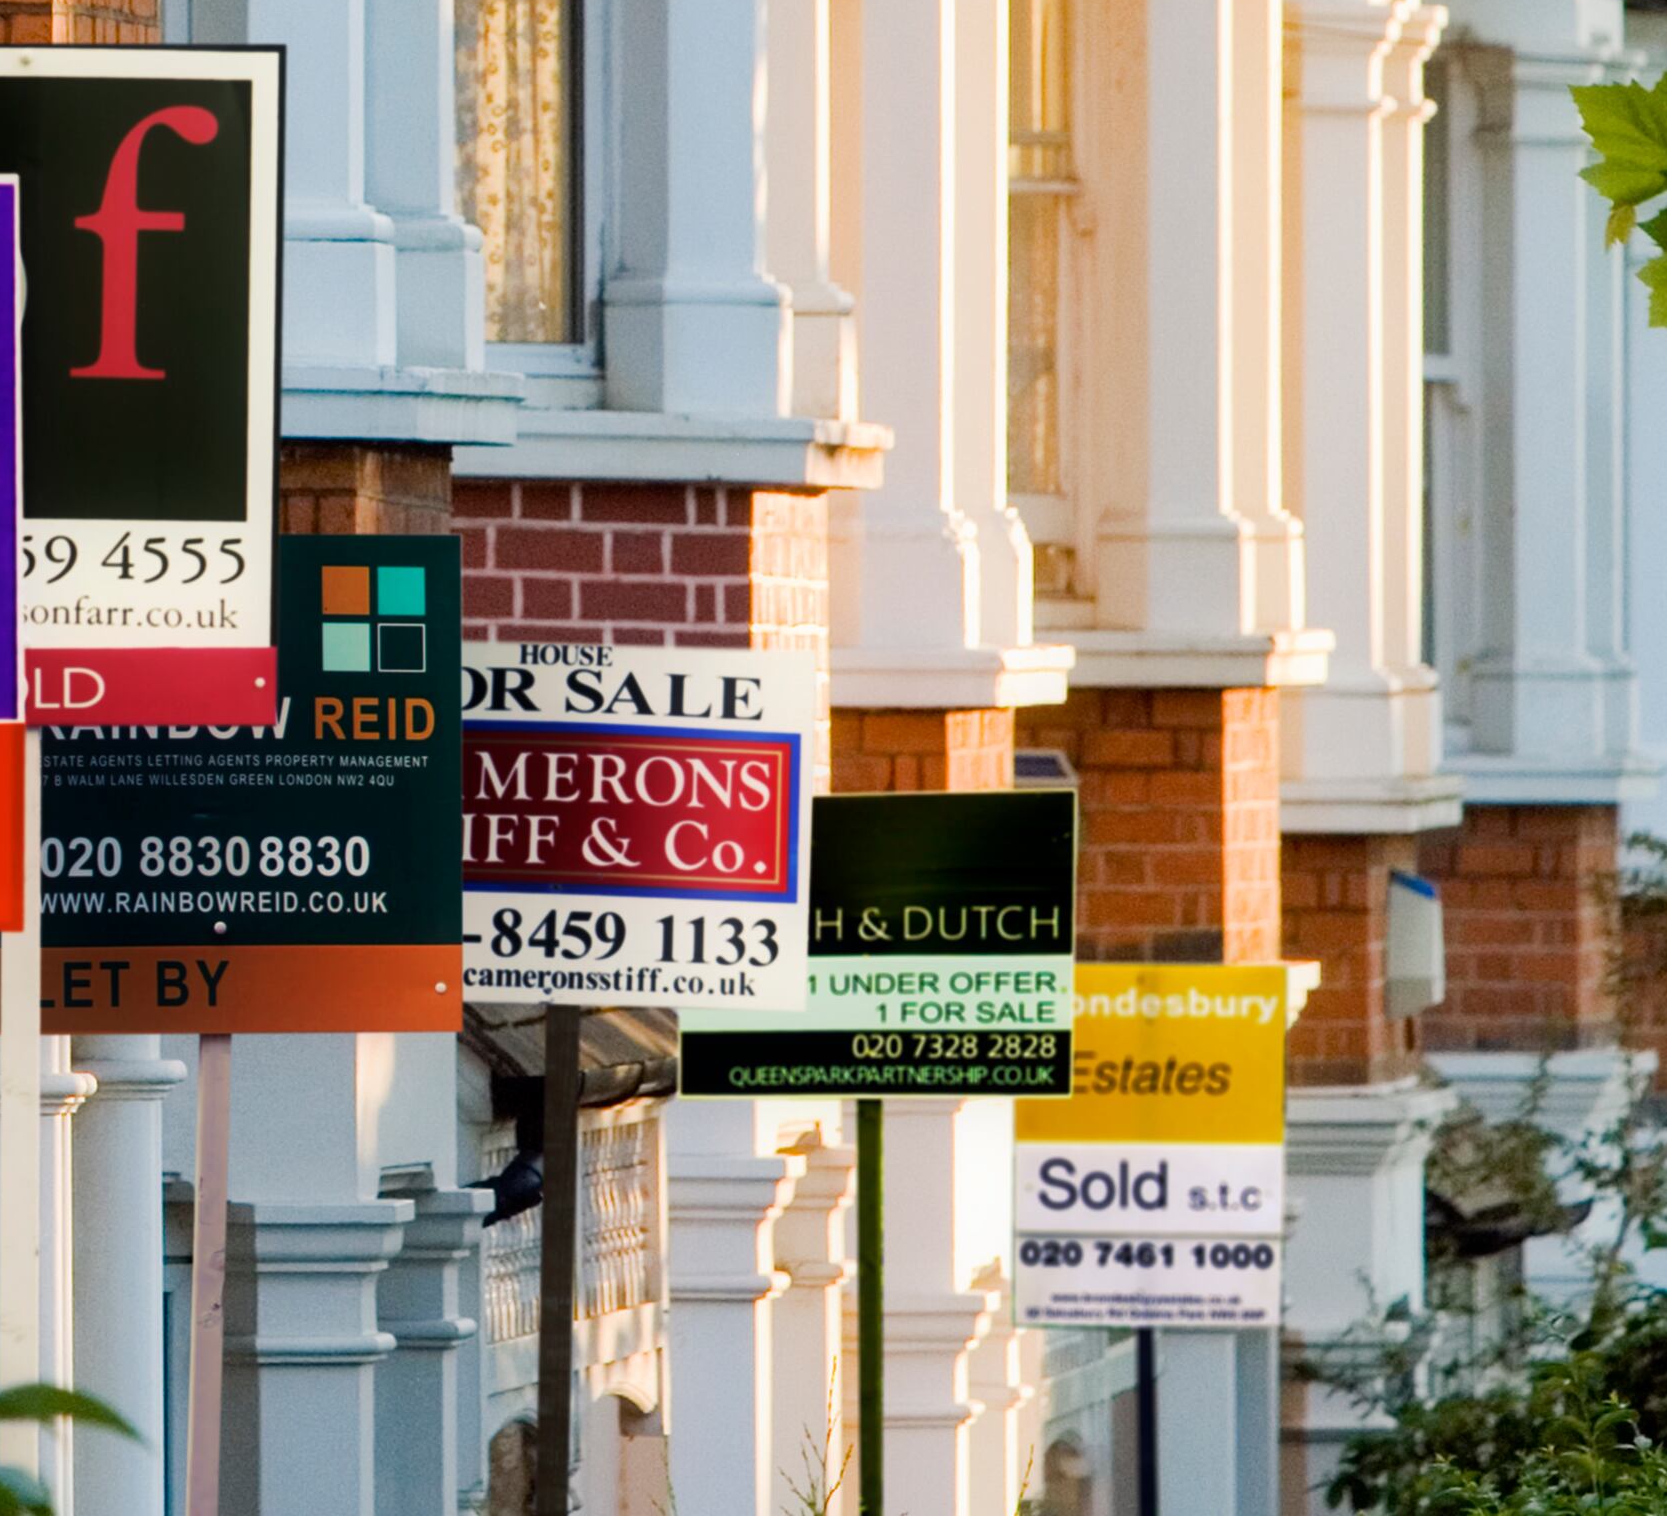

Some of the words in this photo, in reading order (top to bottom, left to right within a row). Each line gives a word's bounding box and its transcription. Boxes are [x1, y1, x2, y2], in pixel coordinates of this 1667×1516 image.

[69, 105, 218, 379] f
[101, 531, 245, 584] 4555
[519, 643, 613, 667] HOUSE
[24, 667, 105, 709] LD
[565, 668, 764, 721] SALE
[314, 696, 435, 741] REID
[41, 754, 84, 768] STATE
[89, 755, 142, 767] AGENTS
[147, 754, 203, 767] LETTING
[208, 754, 260, 767] AGENTS
[266, 754, 334, 767] PROPERTY
[339, 755, 428, 768] MANAGEMENT
[67, 774, 105, 786] WALM
[110, 774, 143, 786] LANE
[149, 773, 224, 785] WILLESDEN
[229, 774, 274, 785] GREEN
[279, 774, 332, 786] LONDON
[337, 775, 364, 786] NW2
[369, 774, 395, 787] 4QU
[462, 751, 771, 812] MERONS
[41, 837, 122, 878] 020
[140, 836, 250, 877] 8830
[259, 836, 370, 877] 8830
[582, 817, 641, 868] &
[664, 820, 767, 874] Co.
[40, 891, 388, 914] WWW.RAINBOWREID.CO.UK
[815, 907, 843, 941] H
[857, 906, 893, 941] &
[903, 906, 1060, 941] DUTCH
[656, 915, 779, 967] 1133
[157, 960, 230, 1007] BY
[463, 967, 756, 998] cameronsstiff.co.uk
[829, 973, 940, 996] UNDER
[949, 971, 1057, 995] OFFER
[876, 1002, 887, 1024] 1
[900, 1002, 965, 1024] FOR
[975, 1001, 1056, 1024] SALE
[852, 1034, 903, 1059] 020
[912, 1034, 978, 1059] 7328
[987, 1034, 1057, 1059] 2828
[729, 1065, 1055, 1088] QUEENSPARKPARTNERSHIP.CO.UK
[1074, 1050, 1232, 1097] Estates
[1038, 1158, 1168, 1211] Sold
[1020, 1240, 1083, 1267] 020
[1095, 1241, 1174, 1269] 7461
[1192, 1243, 1274, 1270] 1000
